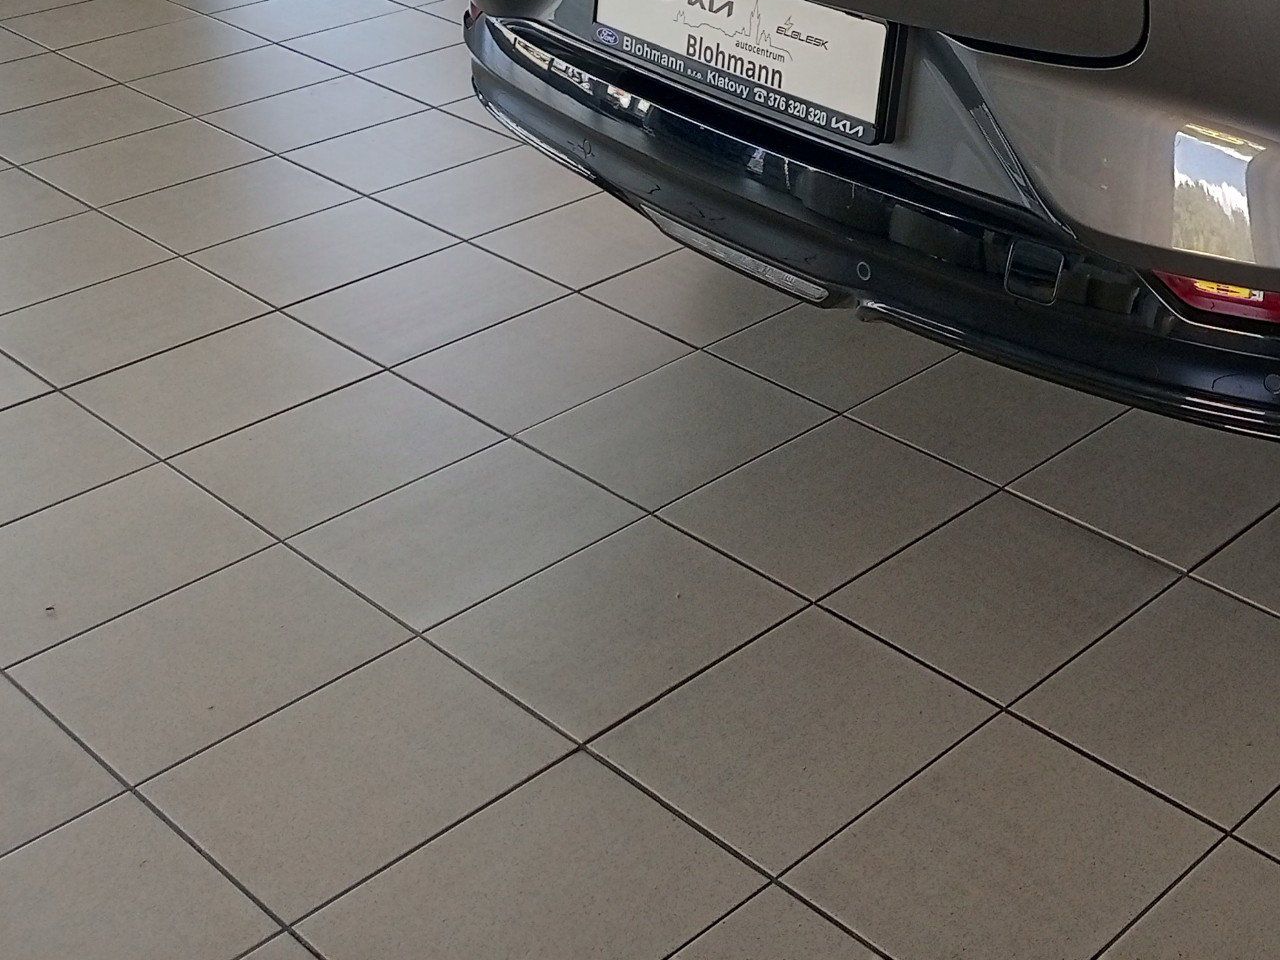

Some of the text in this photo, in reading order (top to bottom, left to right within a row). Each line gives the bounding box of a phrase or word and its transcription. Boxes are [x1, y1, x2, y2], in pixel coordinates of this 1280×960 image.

[686, 33, 783, 89] Blohmann
[735, 40, 785, 62] autocentrum
[599, 28, 618, 44] Ford
[622, 36, 685, 72] Blohmann
[707, 69, 750, 98] Klatovy
[767, 92, 787, 111] 376
[788, 100, 807, 118] 320
[808, 107, 827, 126] 320
[831, 116, 864, 138] KIA
